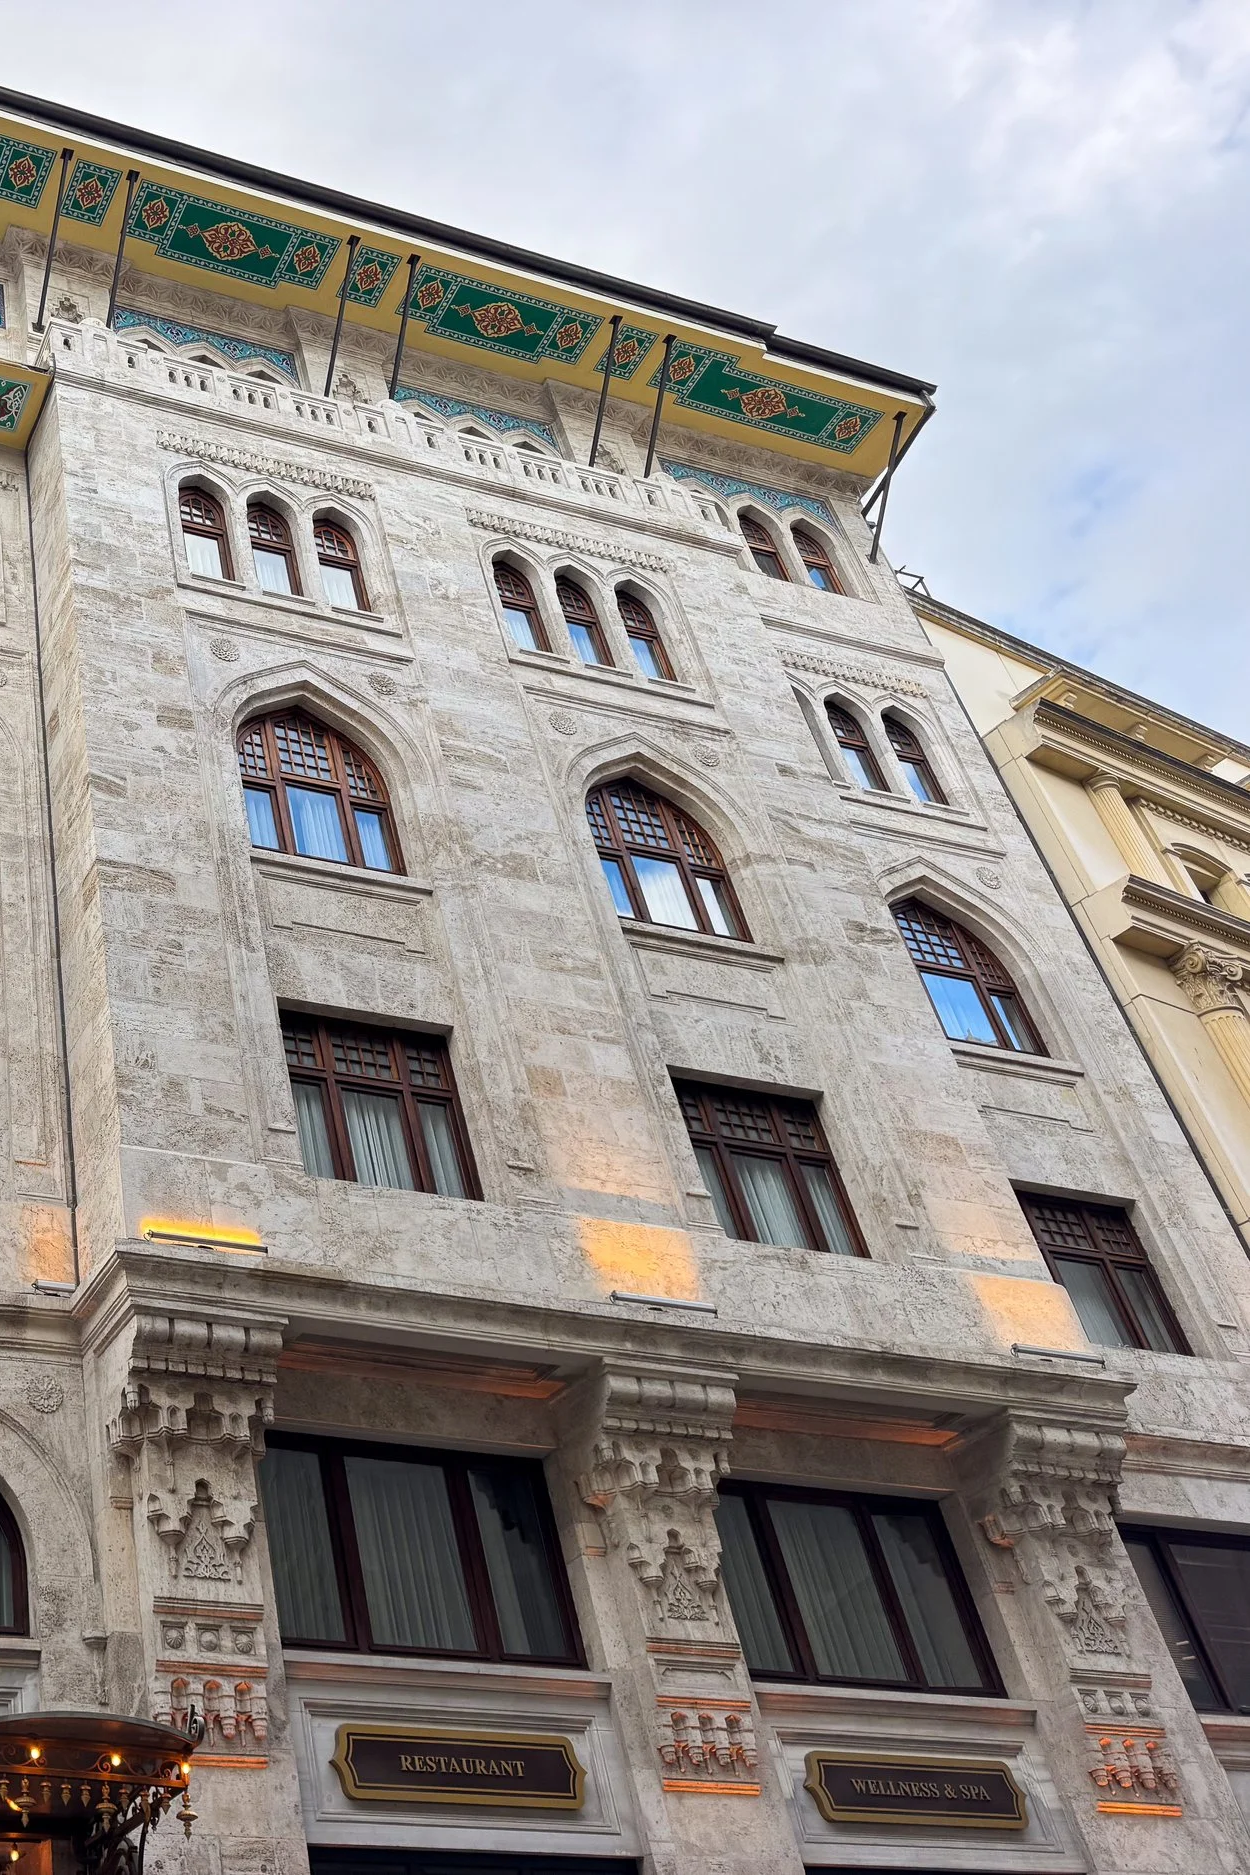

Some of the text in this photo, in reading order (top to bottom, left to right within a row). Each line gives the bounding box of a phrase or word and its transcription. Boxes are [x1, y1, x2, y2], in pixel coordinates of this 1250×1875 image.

[399, 1754, 525, 1777] RESTAURANT
[850, 1778, 991, 1801] WELLNESS & SPA
